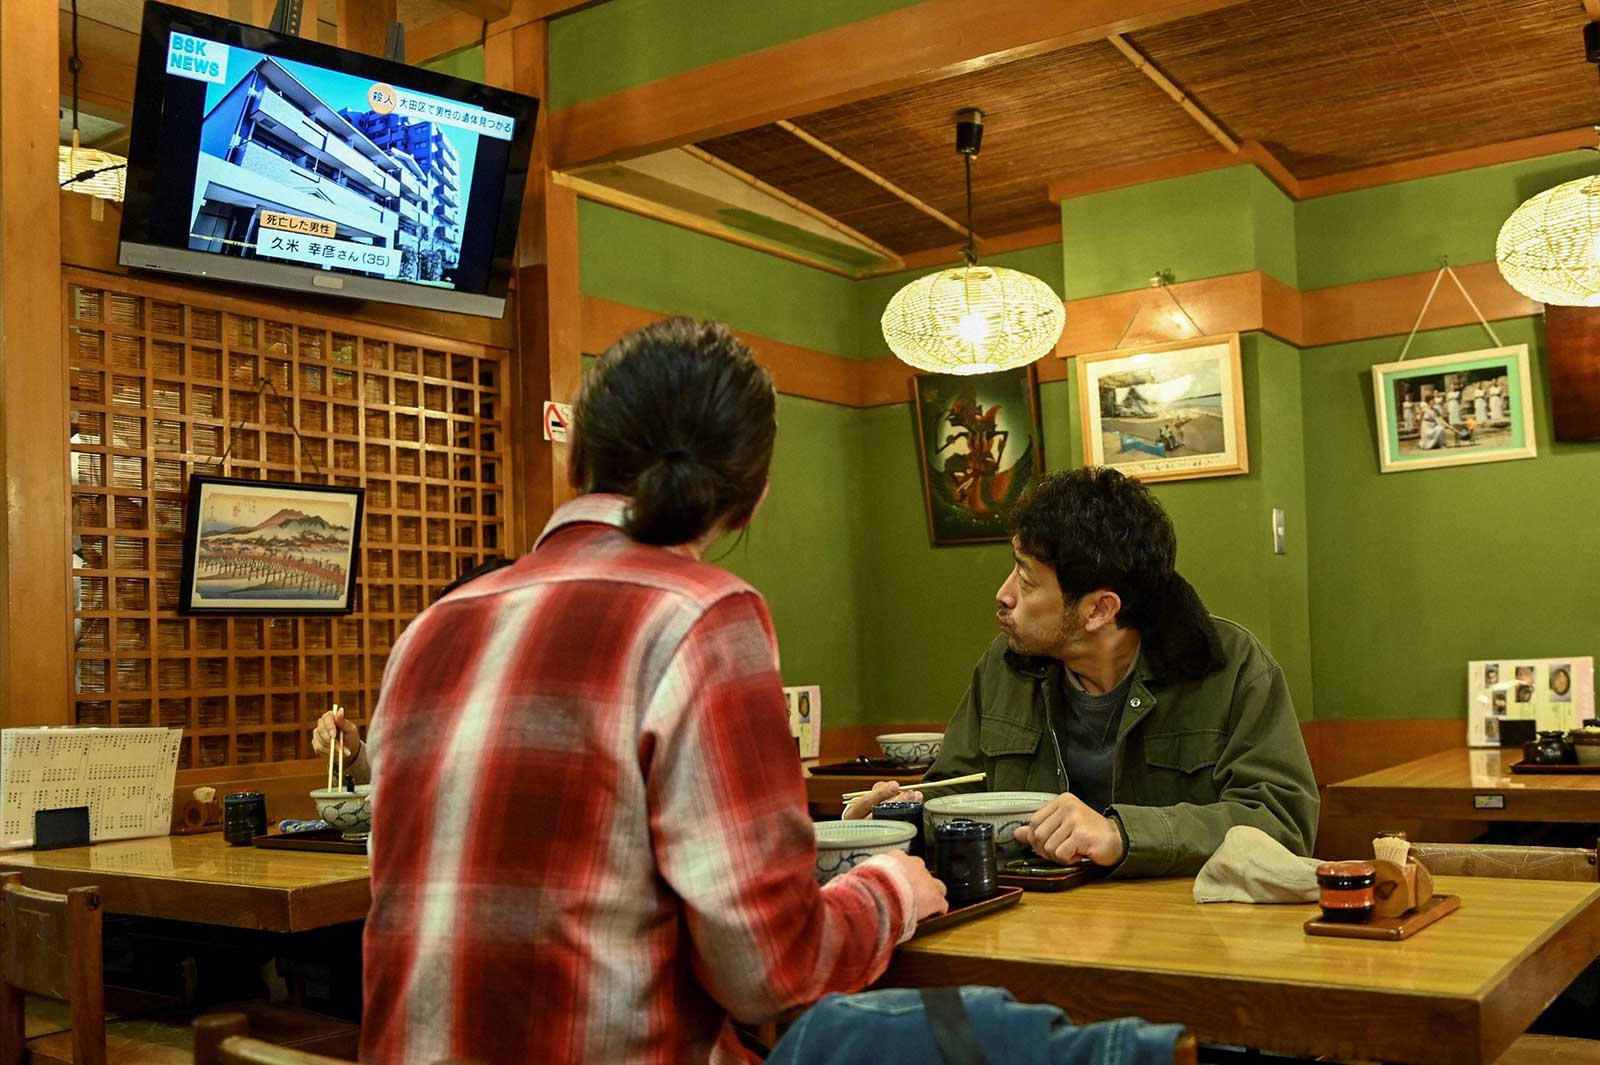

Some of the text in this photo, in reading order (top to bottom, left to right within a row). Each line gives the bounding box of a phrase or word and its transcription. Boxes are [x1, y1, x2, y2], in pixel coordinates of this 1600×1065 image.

[172, 34, 207, 56] BSK
[170, 53, 219, 77] NEWS
[372, 91, 394, 105] 殺人
[399, 98, 511, 133] 大田区で男性の遺体見つかる
[266, 214, 331, 235] 死亡した男性
[271, 236, 299, 253] 久米
